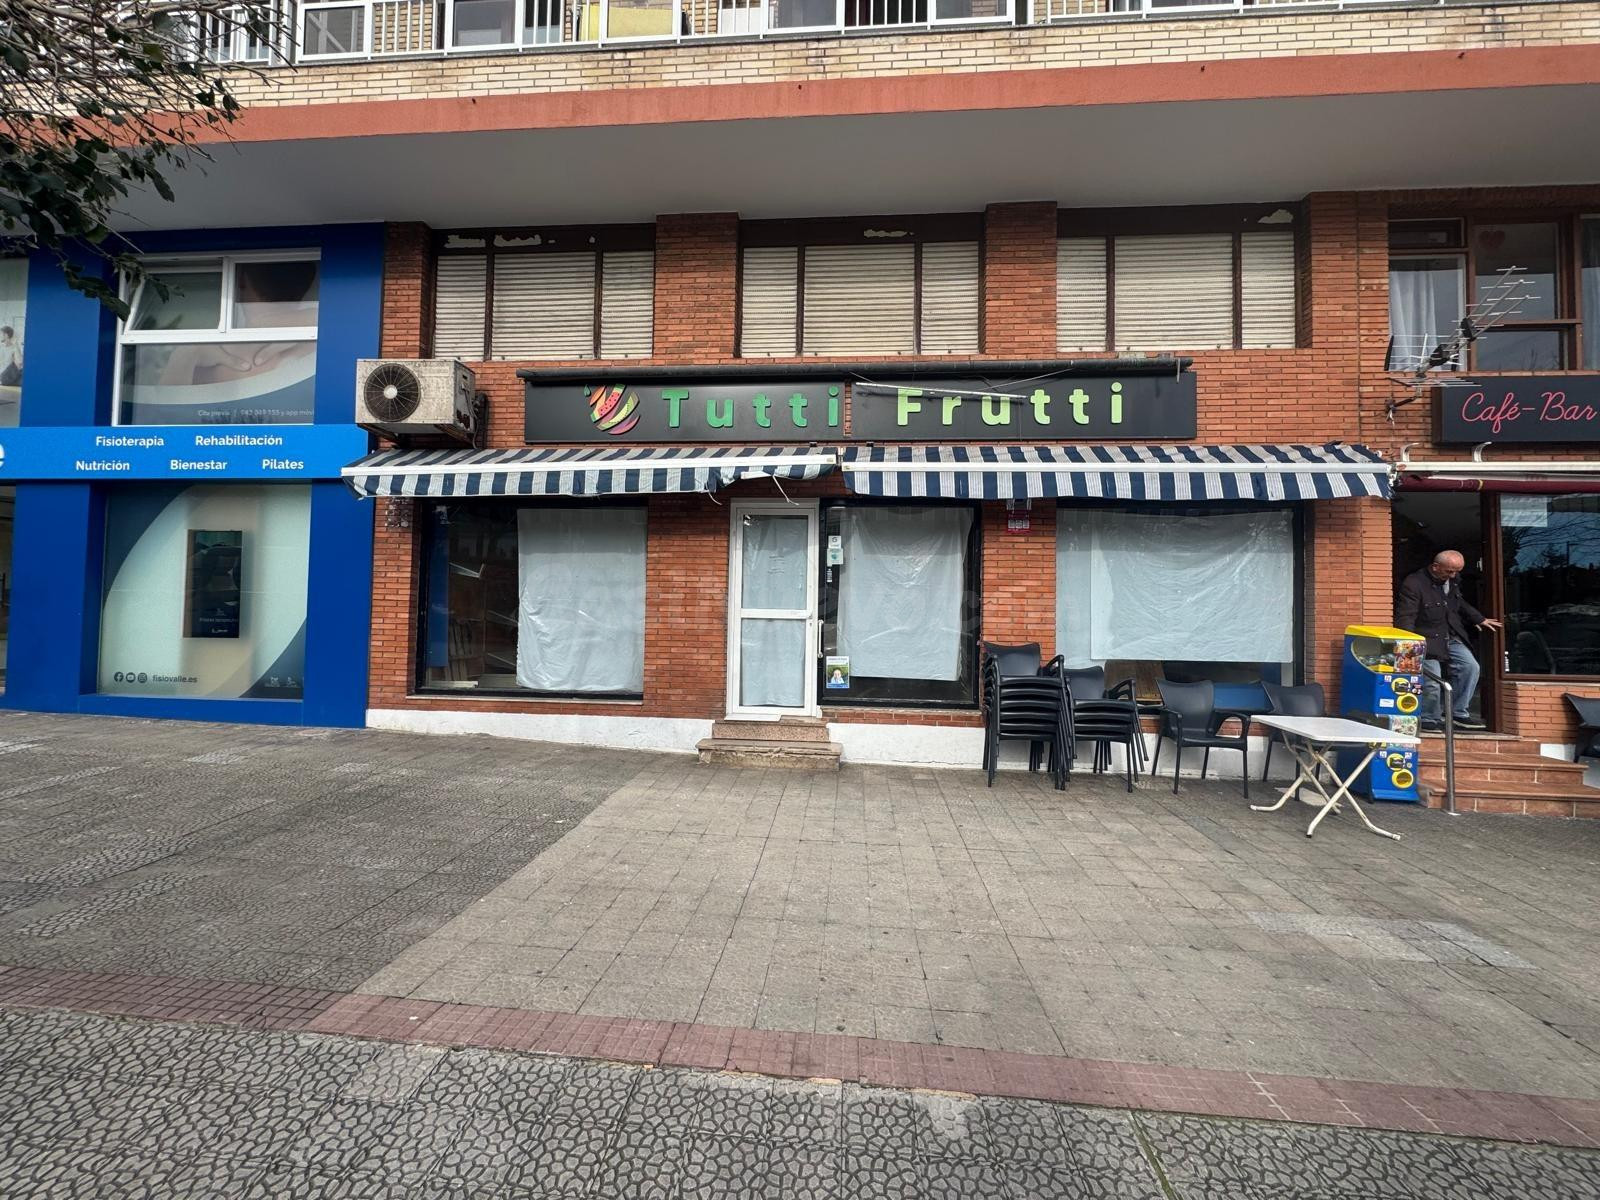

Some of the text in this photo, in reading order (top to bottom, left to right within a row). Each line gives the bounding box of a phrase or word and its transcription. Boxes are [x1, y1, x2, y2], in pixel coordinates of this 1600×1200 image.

[662, 382, 1122, 428] Tutti Frutti
[1462, 392, 1597, 433] Café-Bar
[96, 435, 283, 449] Fisioterapia Rehabilitación
[76, 459, 304, 471] Nutrición Bienestar Pilates
[152, 674, 198, 683] fisiovalle.es
